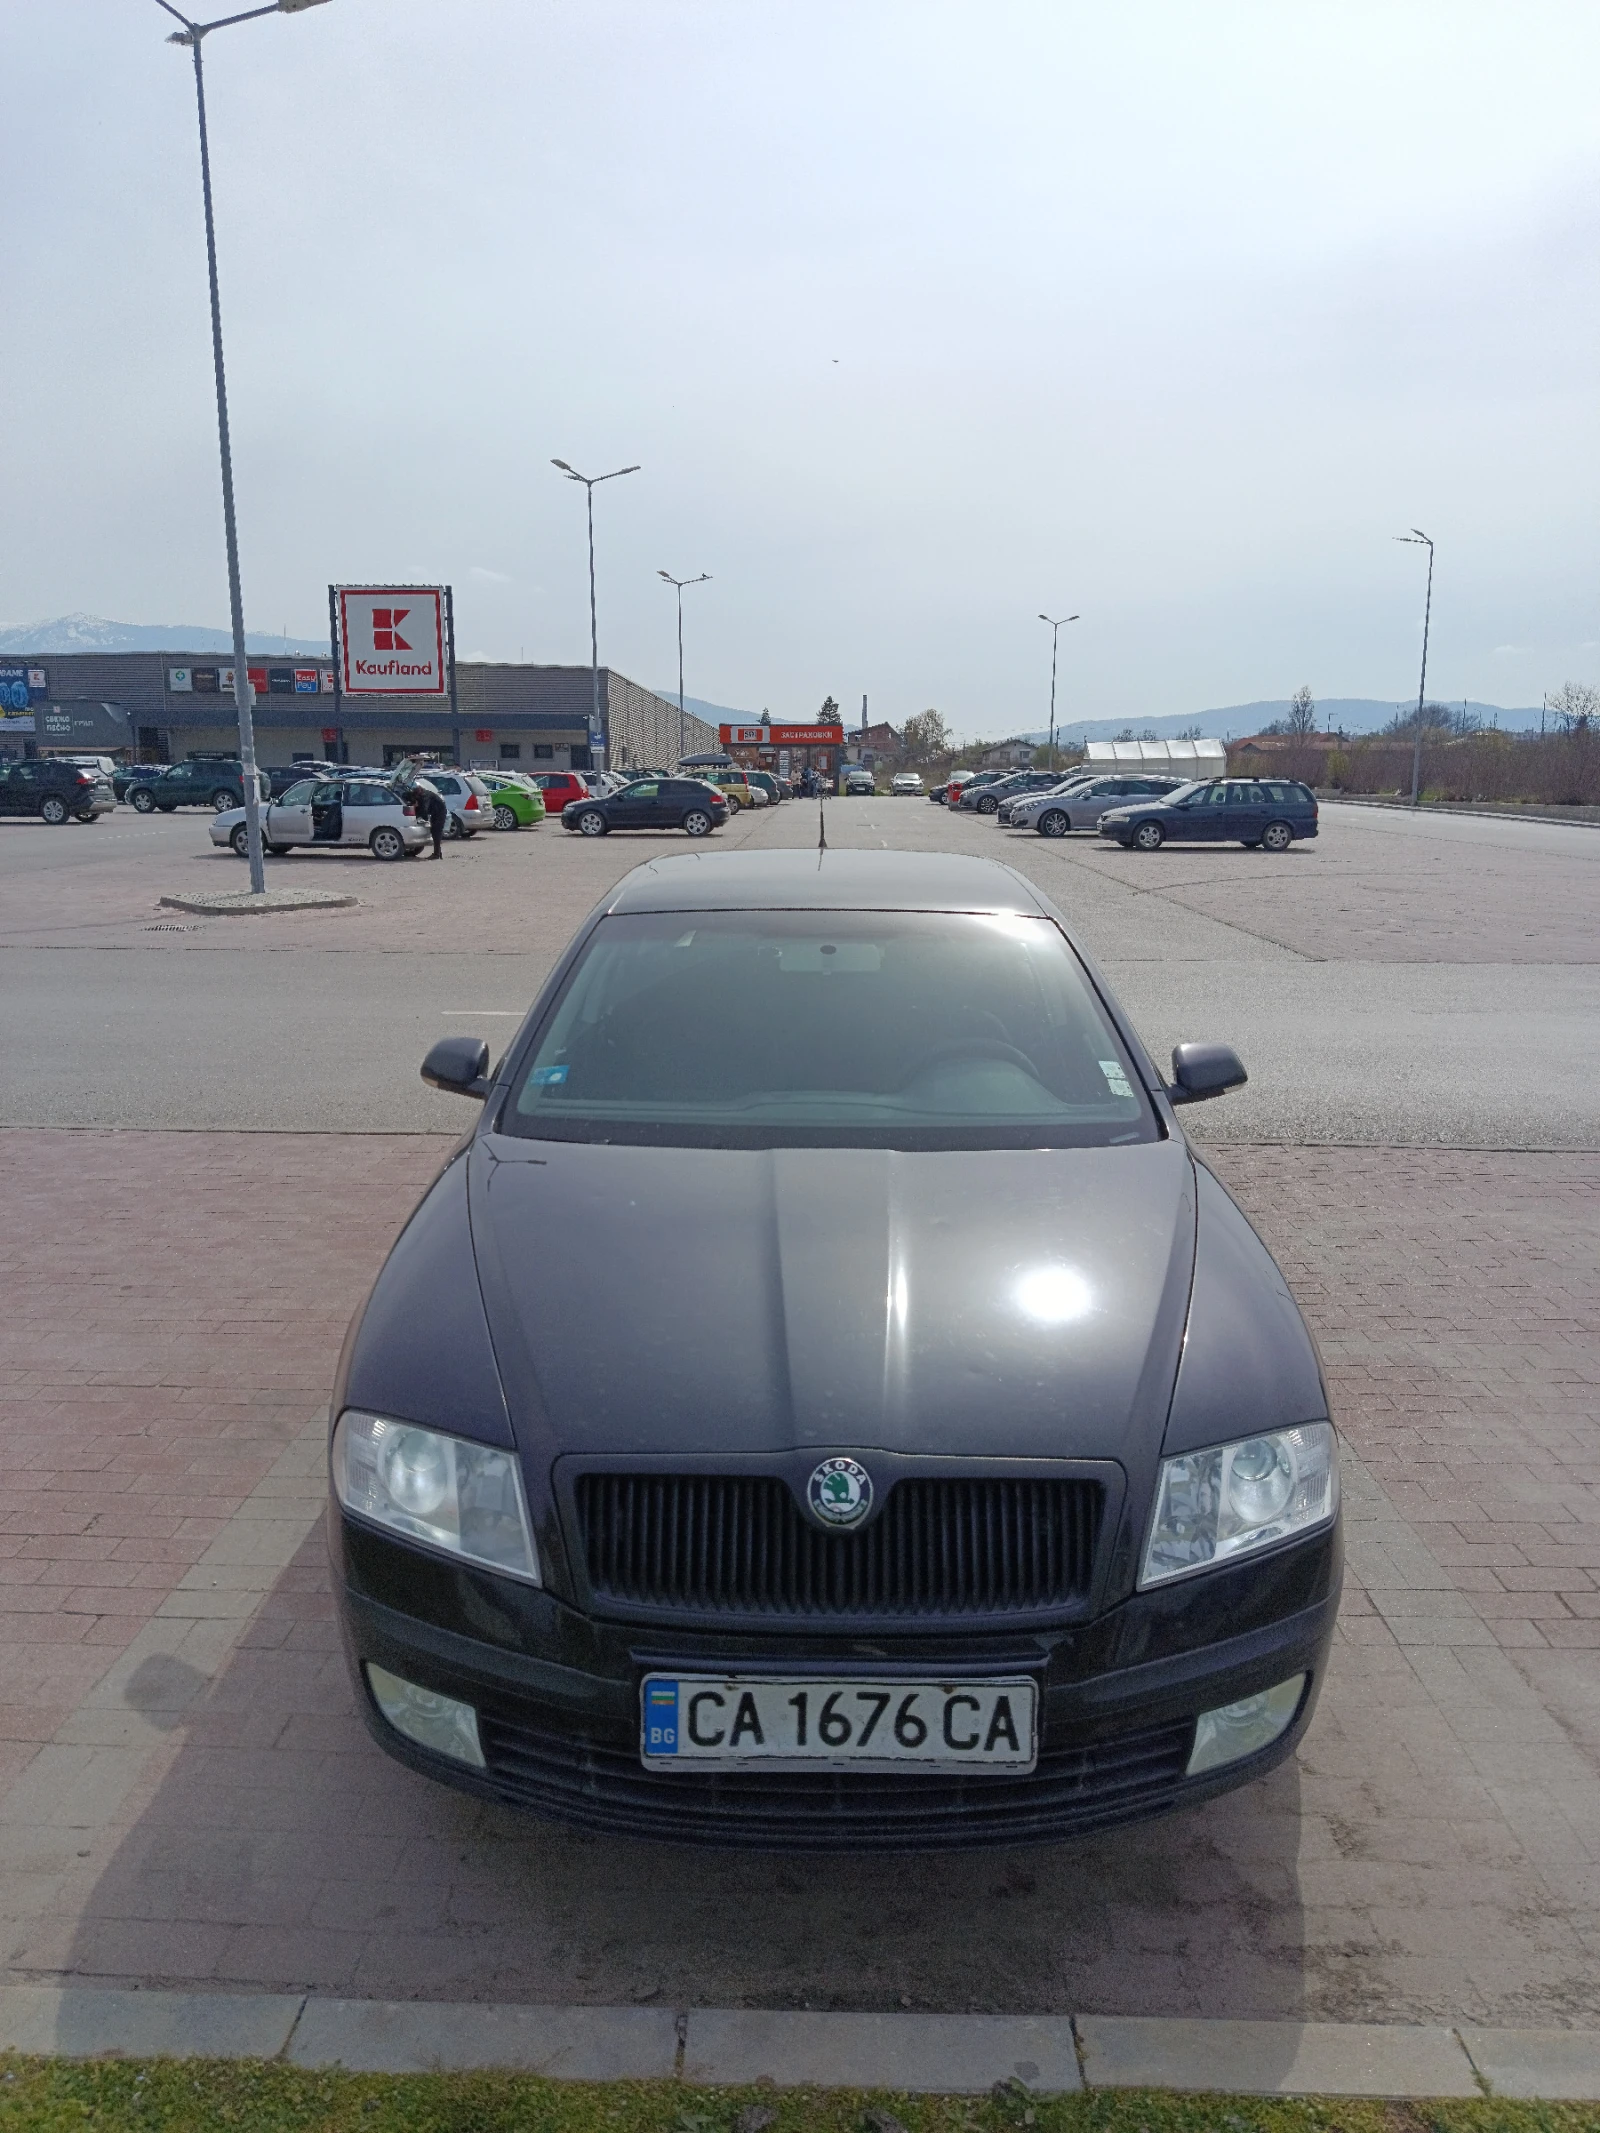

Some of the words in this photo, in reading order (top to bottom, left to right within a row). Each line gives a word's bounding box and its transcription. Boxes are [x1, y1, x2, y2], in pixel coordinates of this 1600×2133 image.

[372, 609, 413, 650] K
[356, 660, 432, 675] Kaufland
[297, 674, 315, 682] Easy
[297, 682, 311, 690] Pay
[781, 731, 833, 739] ЗАСТРАХОВКИ
[688, 1691, 765, 1747] CA
[788, 1692, 928, 1748] 1676
[943, 1695, 1020, 1751] CA
[651, 1728, 675, 1744] BG
